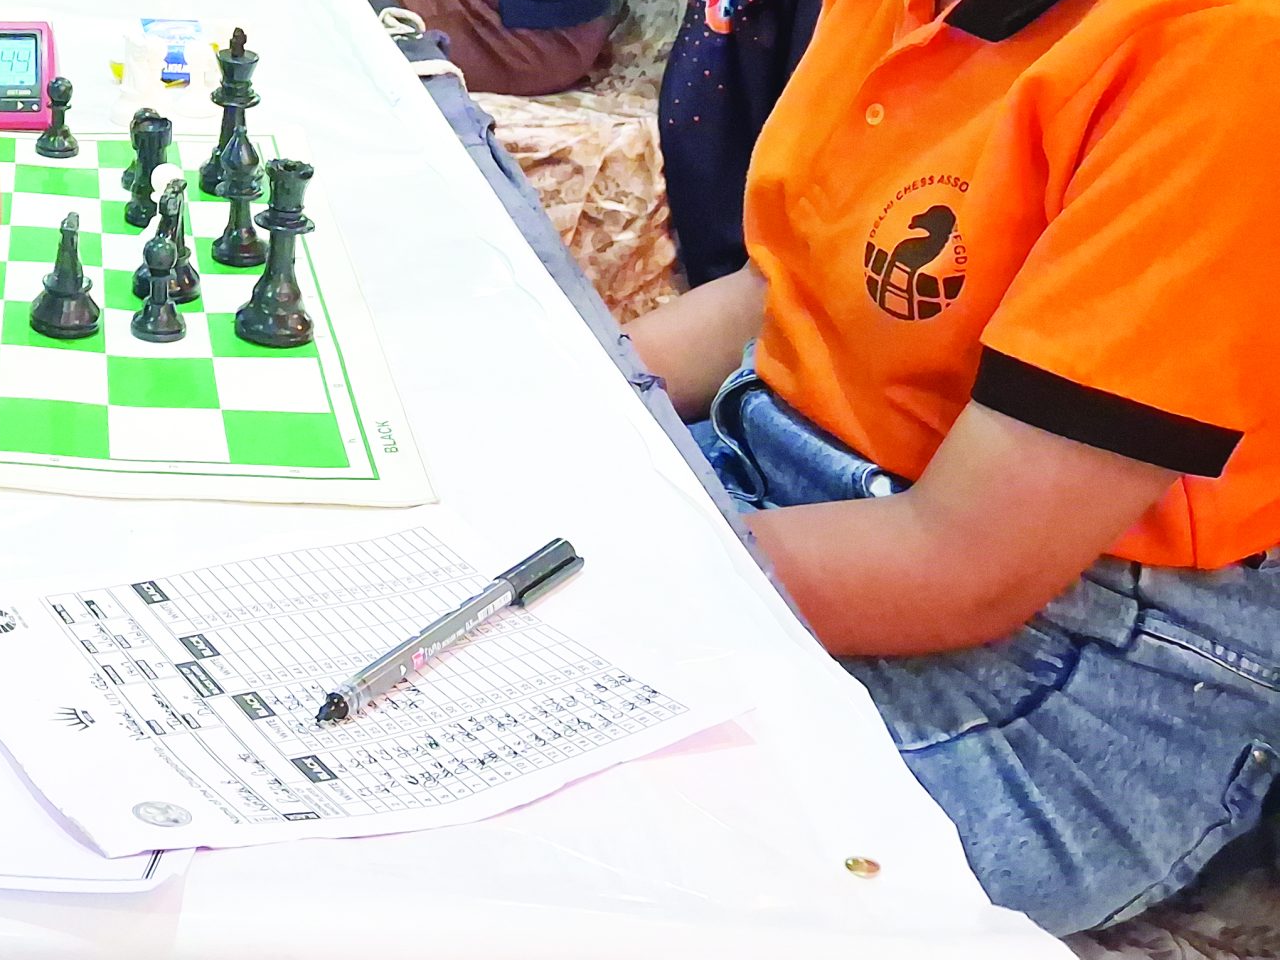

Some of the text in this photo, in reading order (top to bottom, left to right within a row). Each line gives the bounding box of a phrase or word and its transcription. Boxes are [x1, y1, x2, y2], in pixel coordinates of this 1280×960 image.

[869, 200, 894, 238] DELHI
[896, 175, 935, 200] CHESS
[376, 420, 399, 453] BLACK
